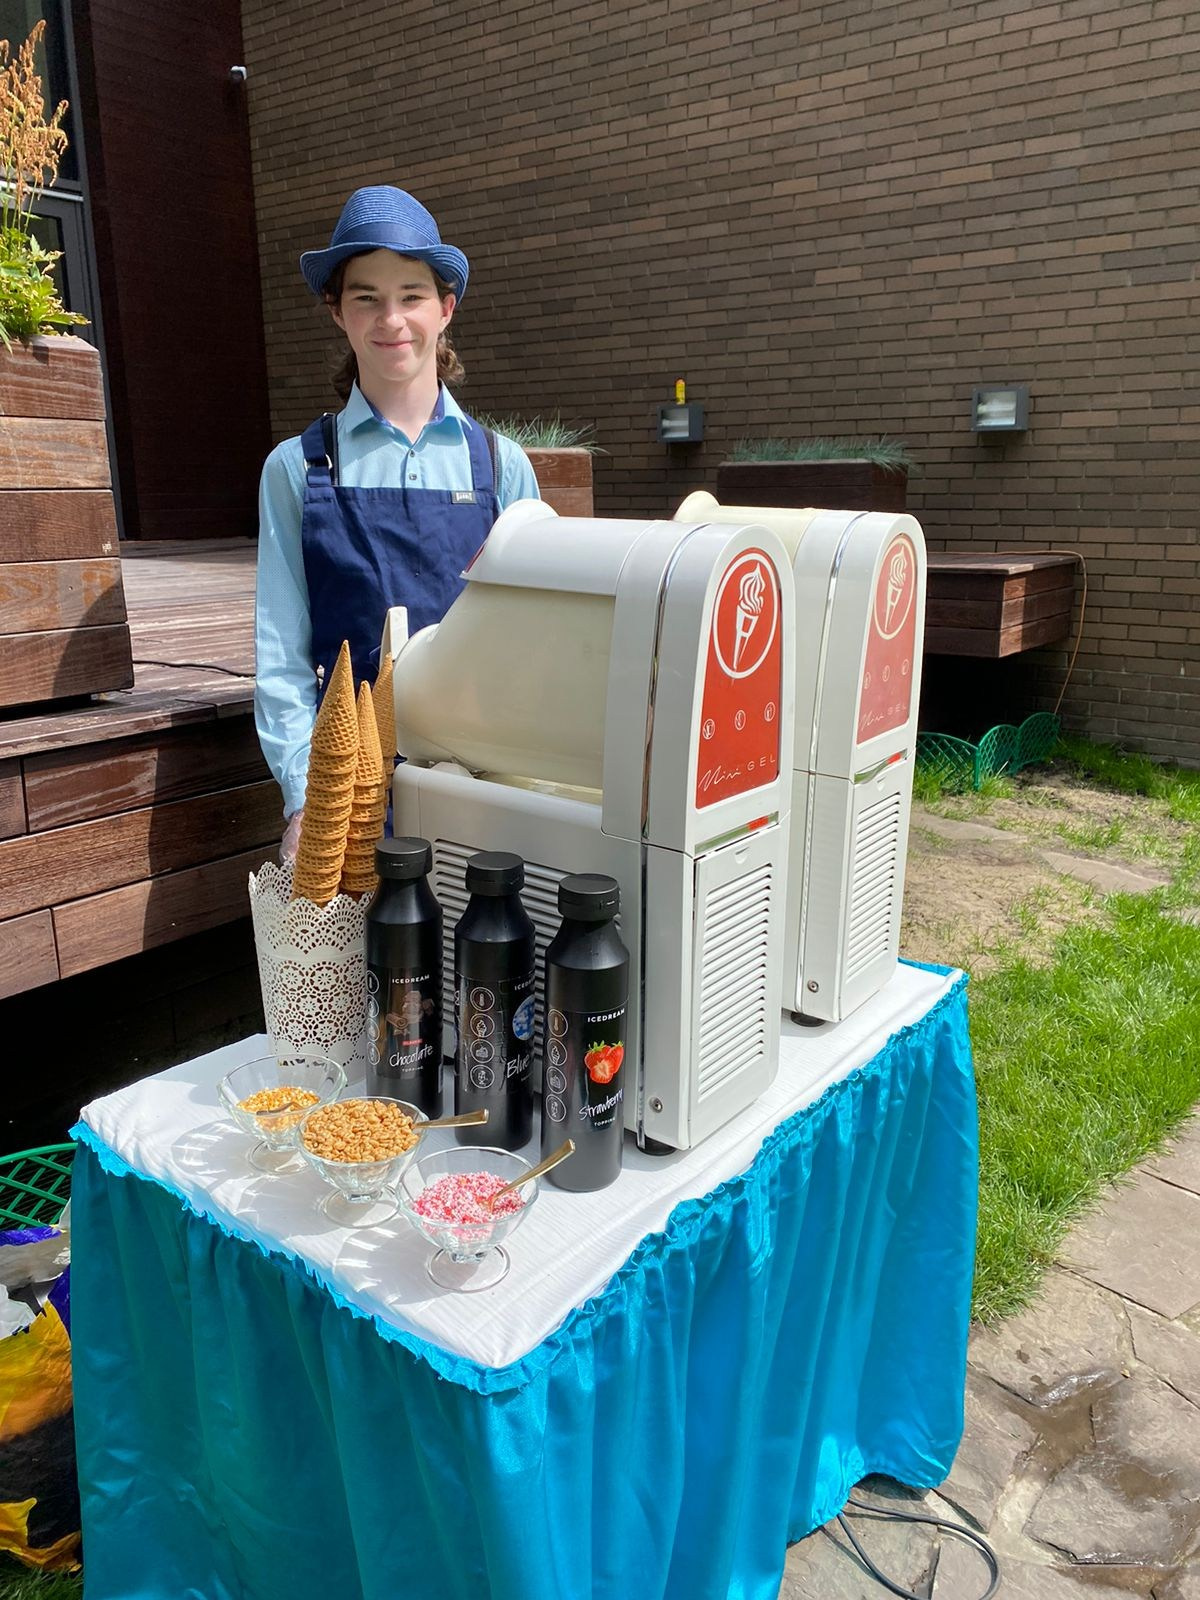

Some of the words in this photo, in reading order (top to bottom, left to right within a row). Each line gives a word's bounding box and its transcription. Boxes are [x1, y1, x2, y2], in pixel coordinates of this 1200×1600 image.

[698, 765, 741, 792] Mini
[747, 754, 776, 771] GEL
[391, 974, 430, 984] ICEDREAM
[587, 1008, 625, 1022] ICEDREAM
[389, 1043, 434, 1067] Chocolate
[579, 1088, 624, 1120] Strawberry
[594, 1117, 616, 1127] TOPPING
